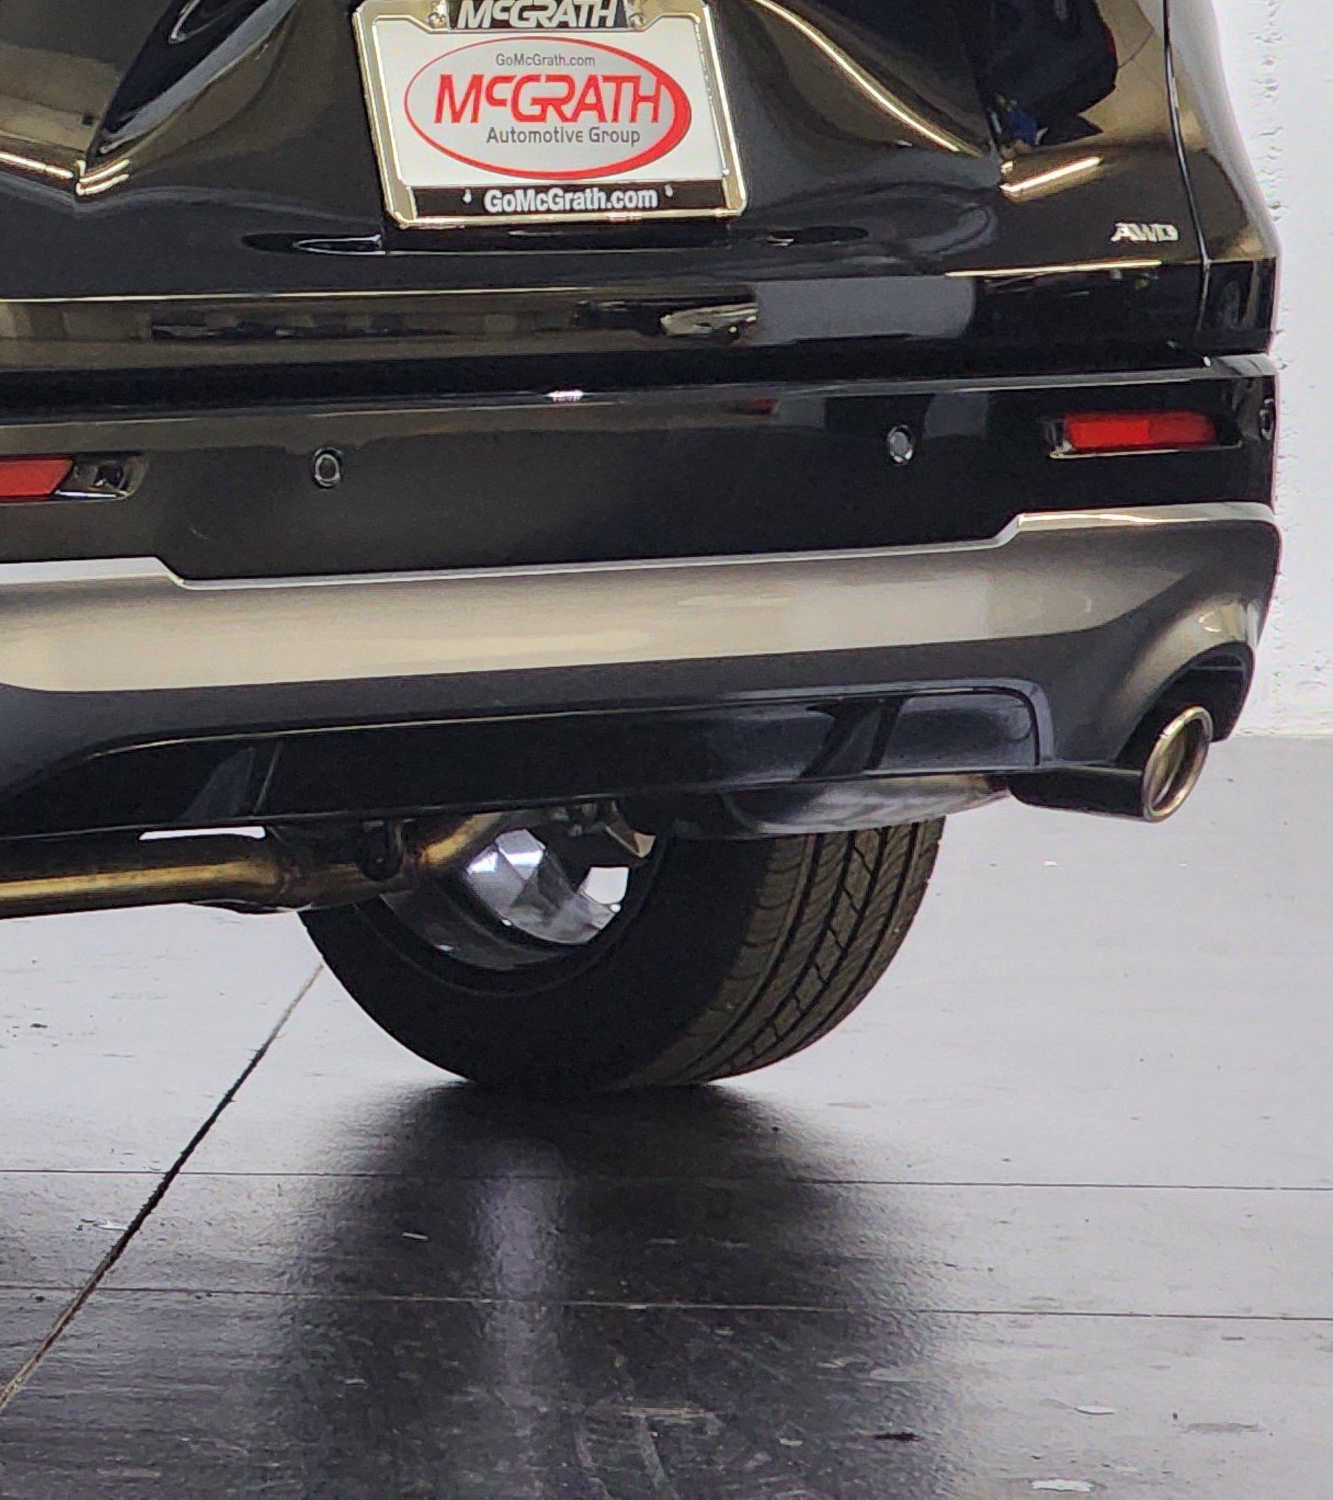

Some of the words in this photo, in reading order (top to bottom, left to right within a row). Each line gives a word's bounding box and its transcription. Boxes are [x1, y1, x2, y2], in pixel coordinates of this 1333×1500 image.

[495, 52, 596, 68] GoMcGrath.com
[485, 126, 584, 144] Automotive
[588, 126, 641, 147] Group
[483, 187, 659, 214] GoMcGrath.com
[1110, 222, 1179, 243] AWD
